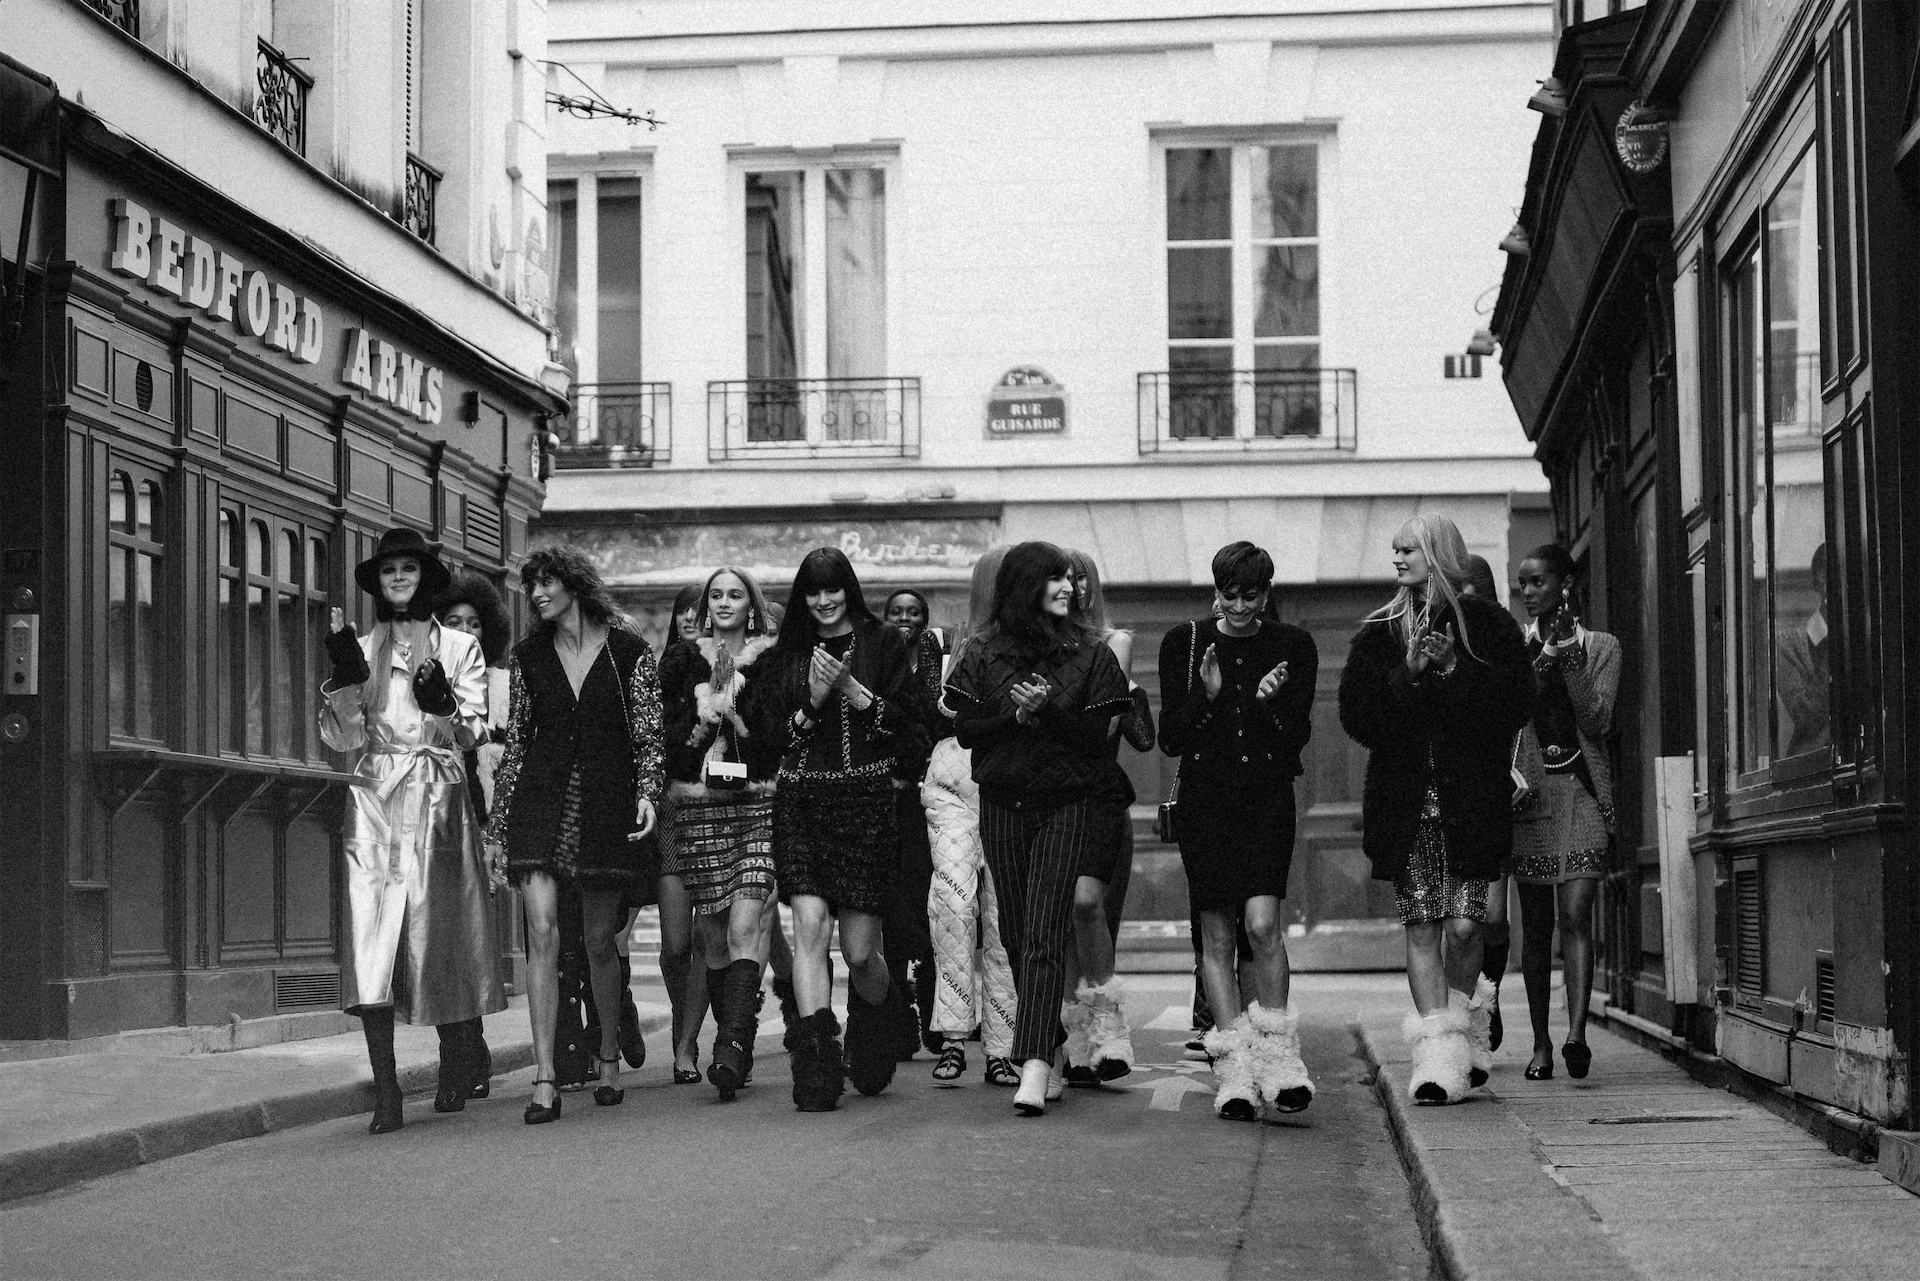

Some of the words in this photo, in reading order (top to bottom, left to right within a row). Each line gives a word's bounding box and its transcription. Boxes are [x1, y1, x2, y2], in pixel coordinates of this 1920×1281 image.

[112, 198, 323, 364] BEDFORD
[343, 327, 443, 425] ARMS
[991, 417, 1062, 431] GUISARDE
[1010, 402, 1042, 416] RUE
[940, 871, 968, 902] CHANEL
[942, 972, 972, 1007] CHANEL
